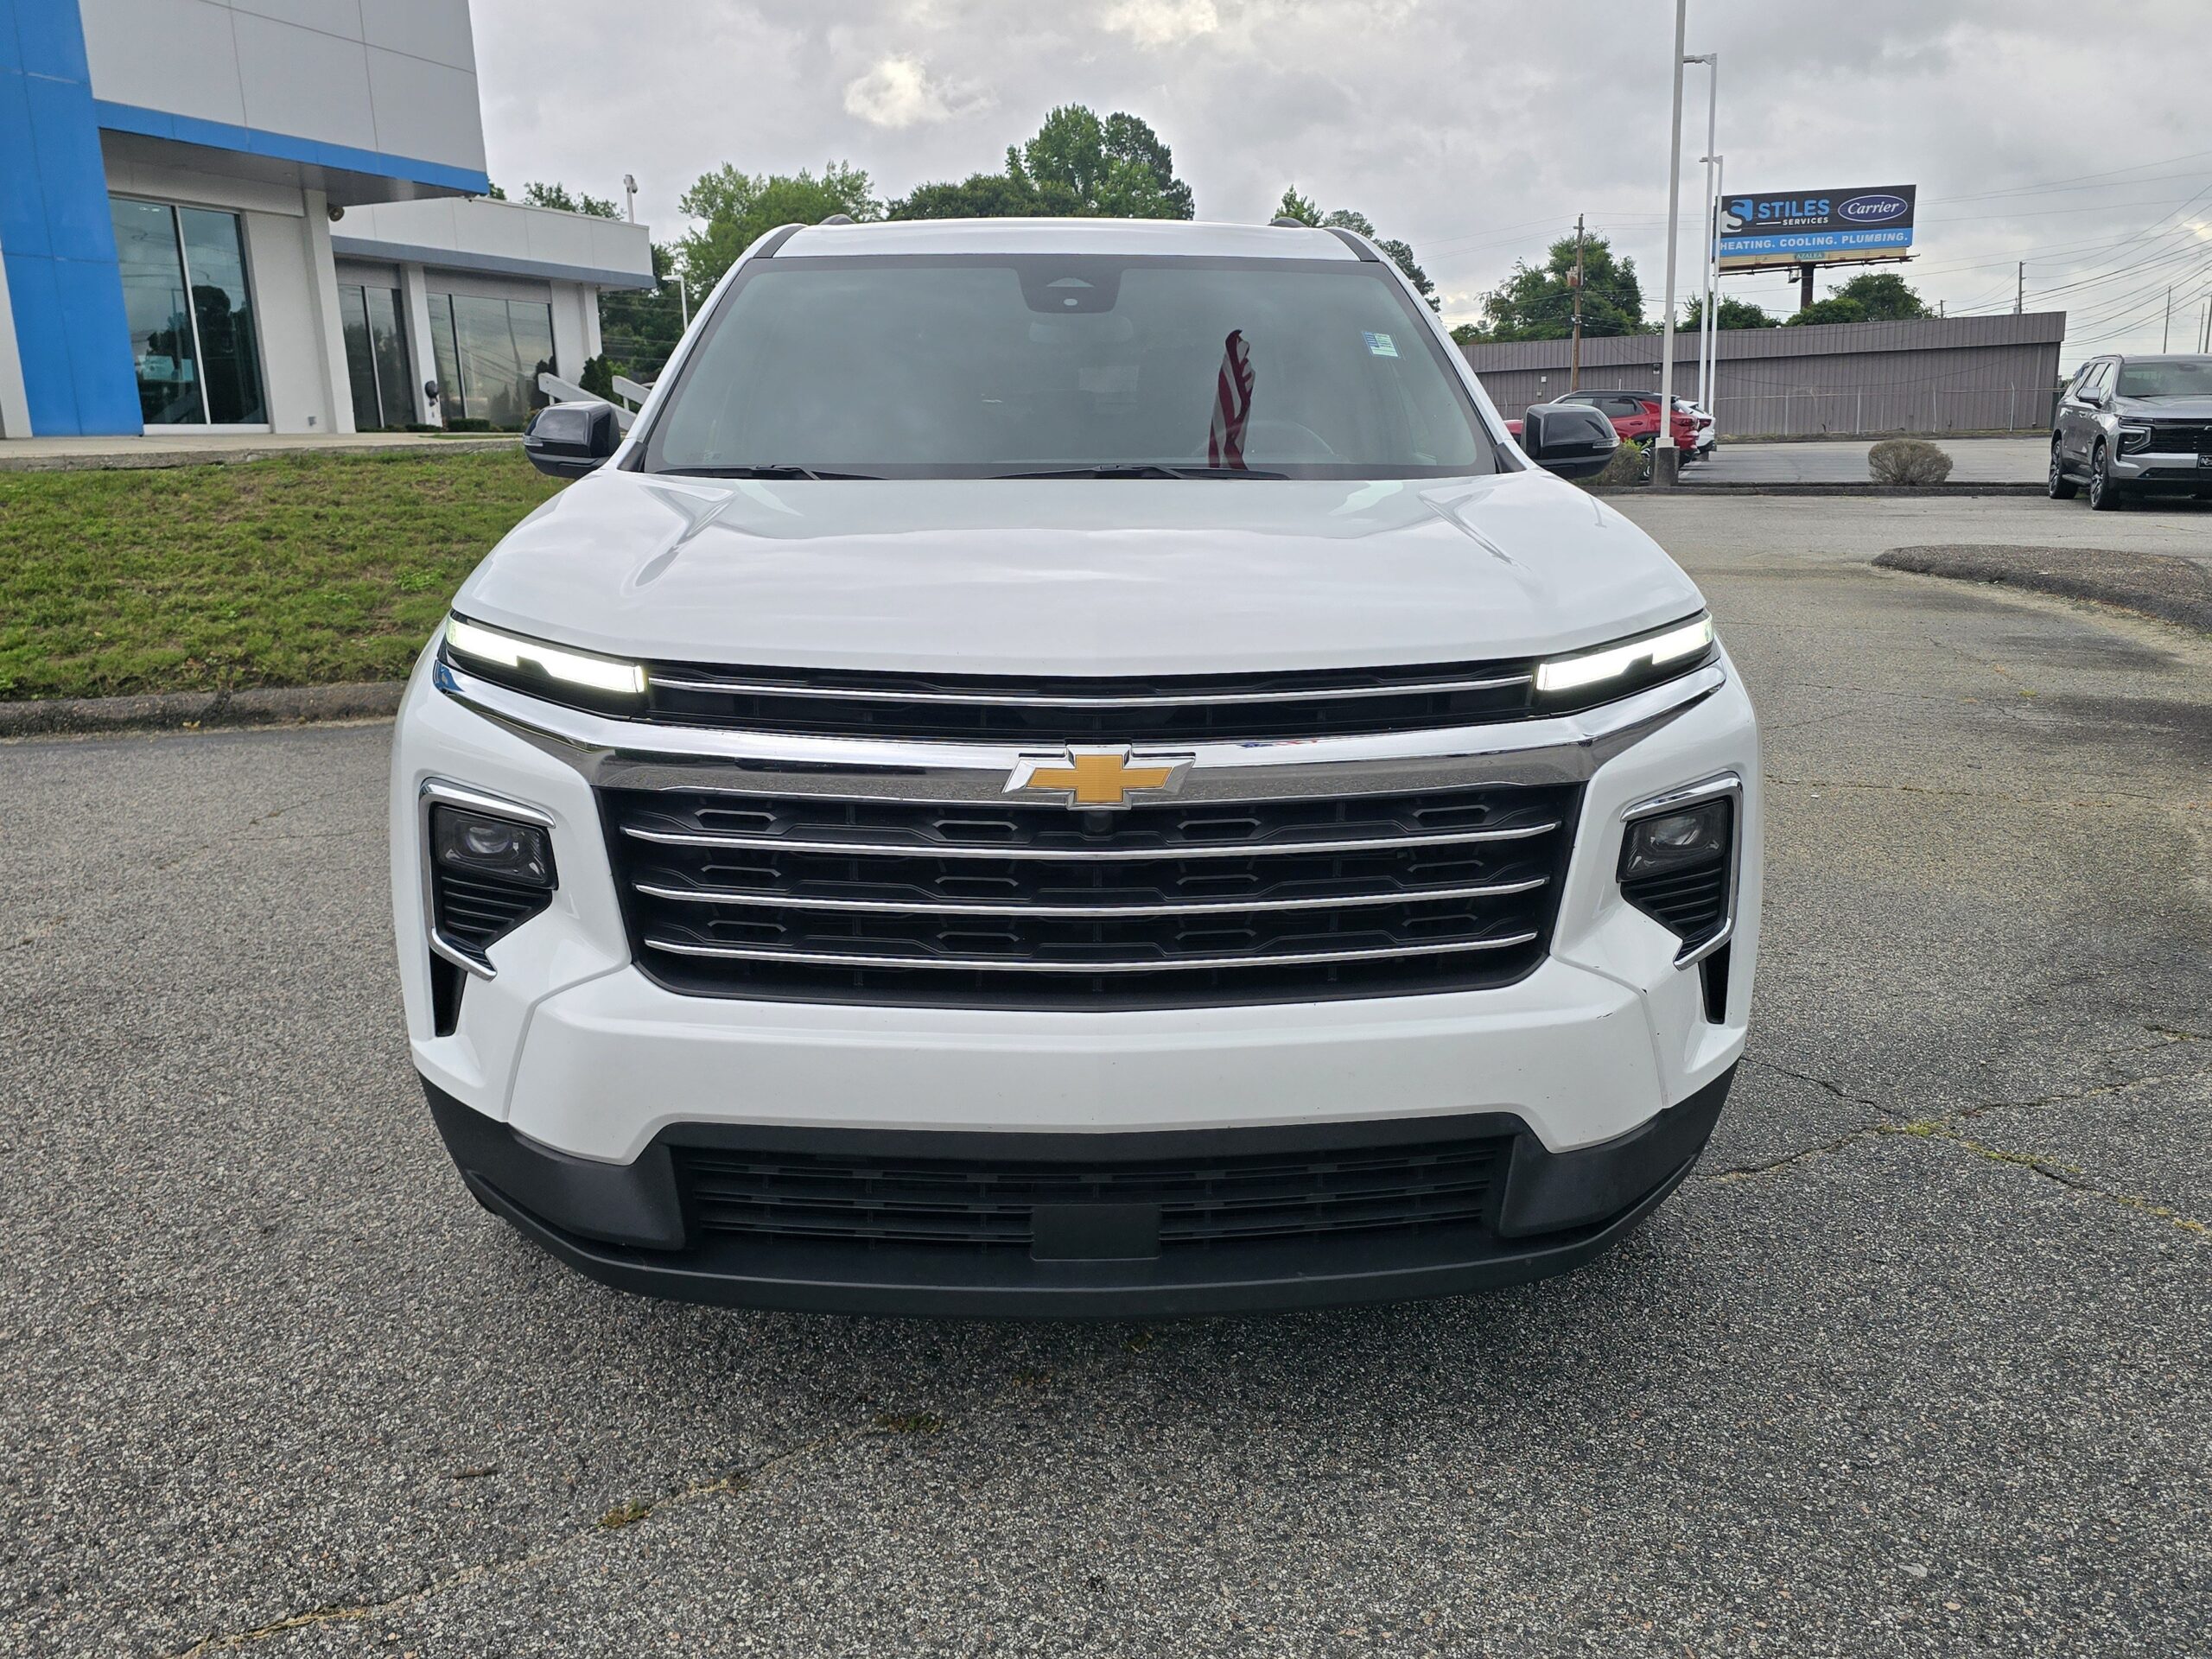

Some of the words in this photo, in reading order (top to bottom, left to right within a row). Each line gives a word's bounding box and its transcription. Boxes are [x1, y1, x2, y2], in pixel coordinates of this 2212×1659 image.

[1758, 199, 1830, 219] STILES
[1847, 201, 1899, 215] Carrier
[1783, 217, 1828, 226] SERVICES
[1720, 239, 1776, 251] HEATING.
[1780, 236, 1837, 247] COOLING.
[1841, 232, 1908, 244] PLUMBING.
